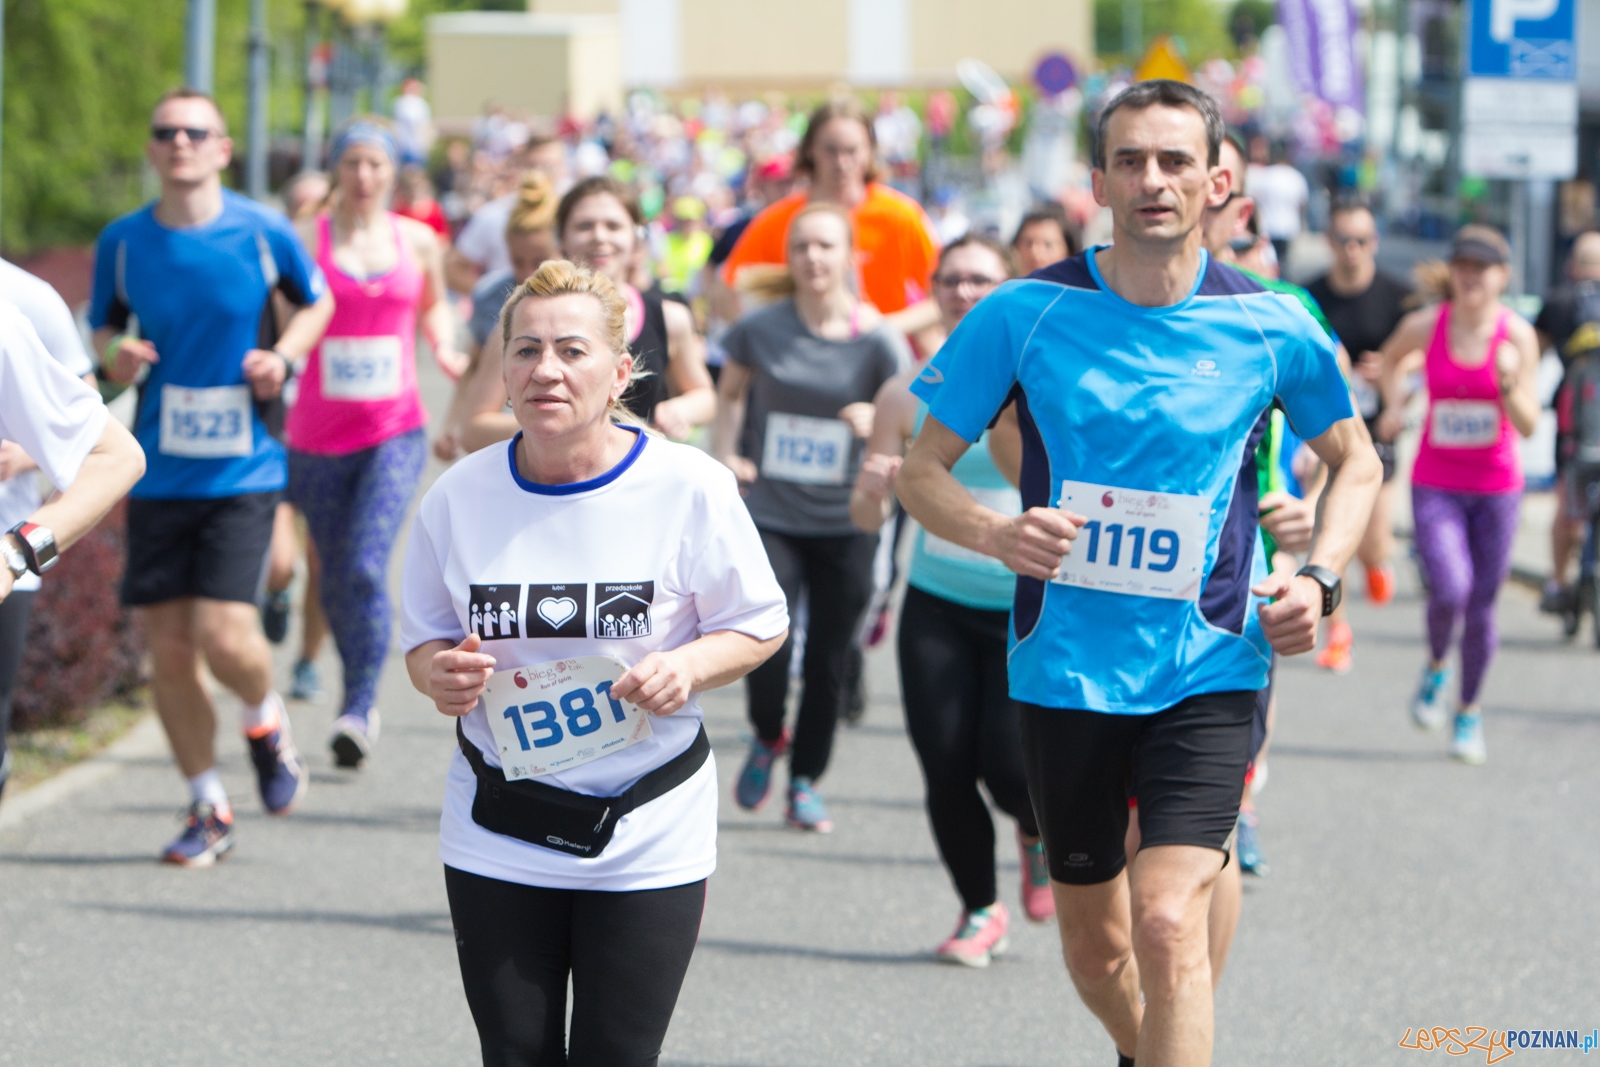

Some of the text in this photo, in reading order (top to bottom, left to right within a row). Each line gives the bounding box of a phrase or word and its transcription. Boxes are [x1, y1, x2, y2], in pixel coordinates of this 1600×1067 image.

[171, 408, 242, 439] 1523
[1083, 519, 1180, 573] 1119
[605, 584, 643, 593] przedszkole
[527, 668, 557, 681] bieg
[503, 679, 627, 752] 1381
[564, 840, 592, 852] Kalenji
